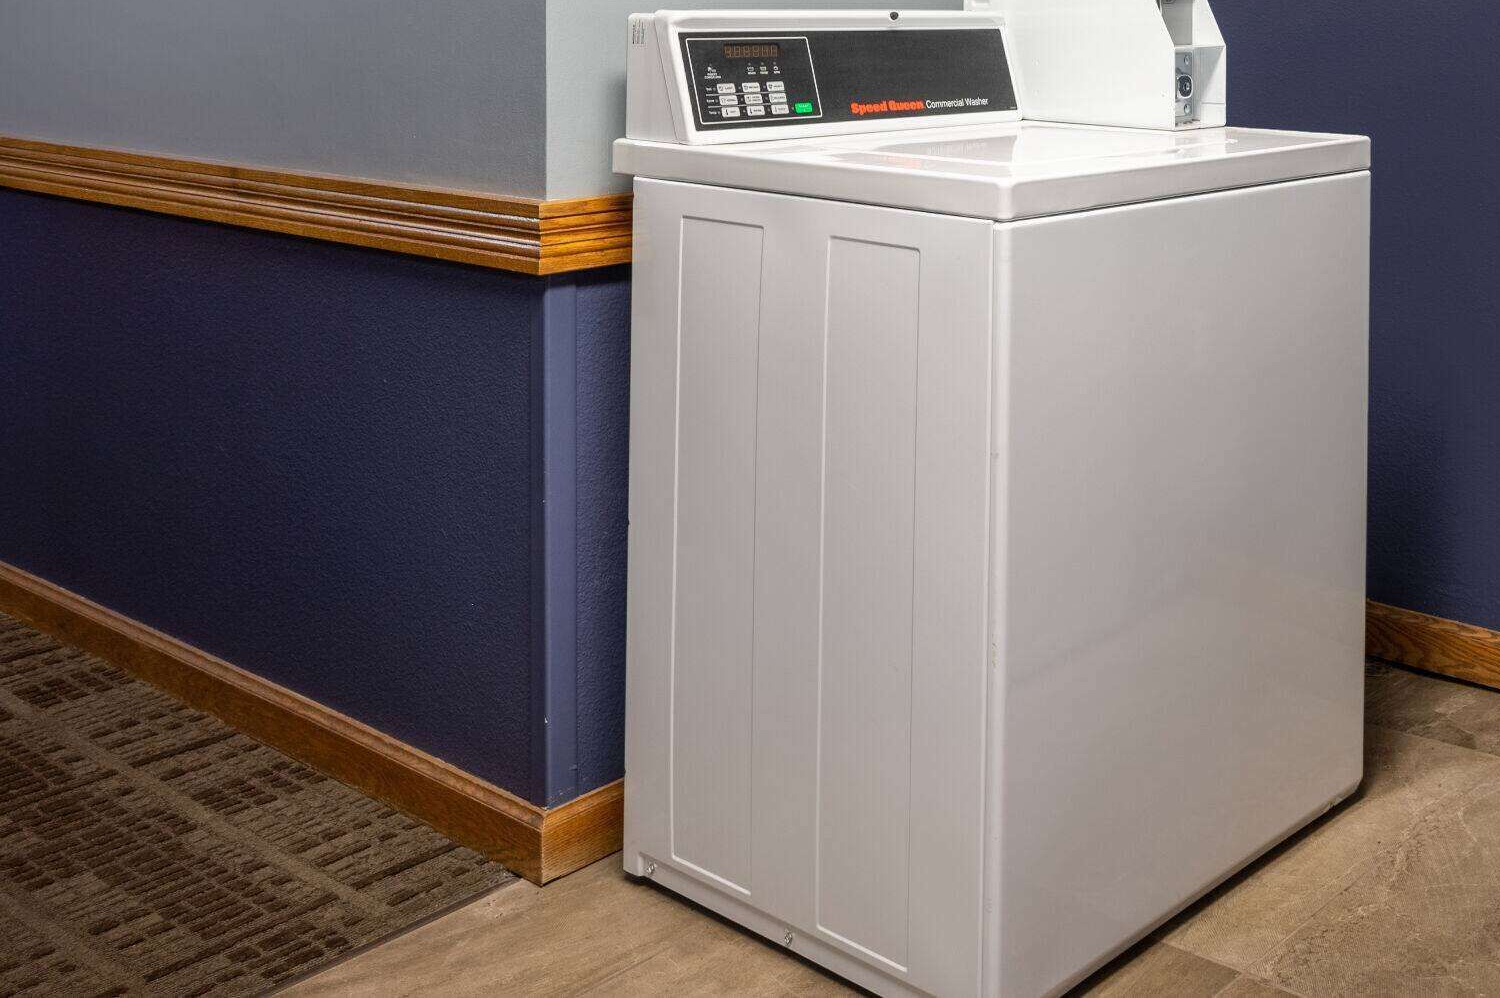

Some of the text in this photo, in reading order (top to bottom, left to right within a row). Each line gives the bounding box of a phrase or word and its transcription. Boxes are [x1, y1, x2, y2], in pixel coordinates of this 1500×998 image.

[851, 96, 988, 115] Speed Queen Commercial Washer
